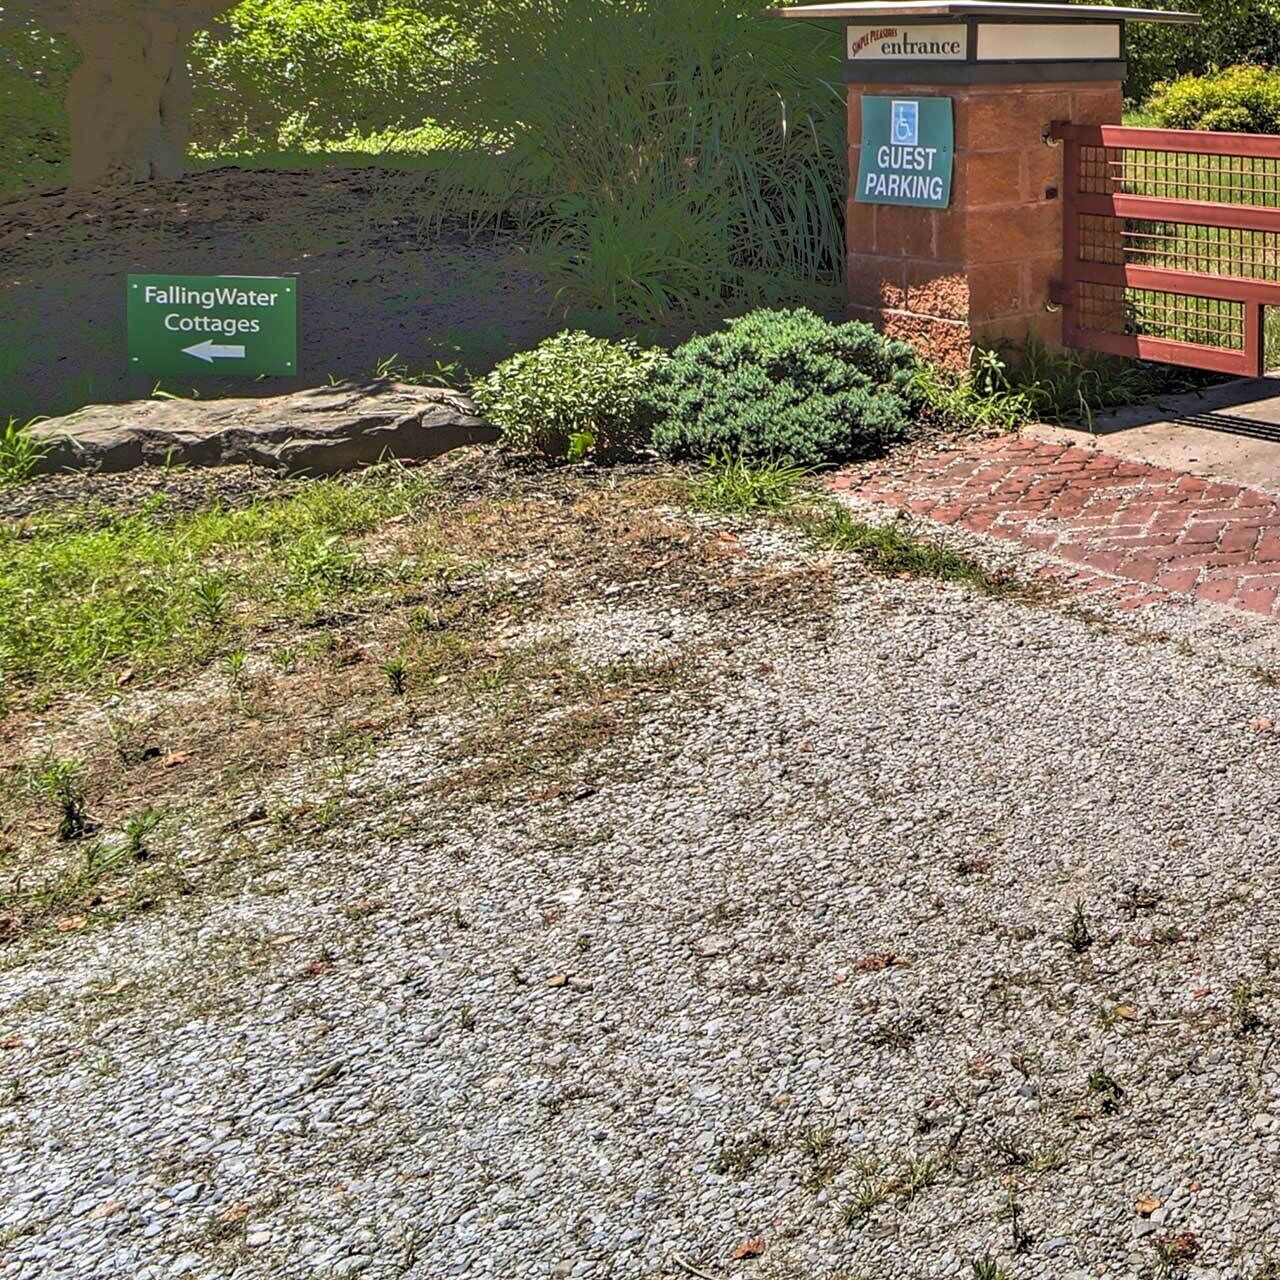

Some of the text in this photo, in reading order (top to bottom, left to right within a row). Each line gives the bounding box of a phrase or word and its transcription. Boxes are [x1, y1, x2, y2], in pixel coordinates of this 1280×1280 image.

[881, 32, 961, 55] entrance
[877, 145, 937, 171] GUEST
[865, 173, 943, 200] PARKING
[145, 286, 278, 309] FallingWater
[164, 313, 260, 336] Cottages
